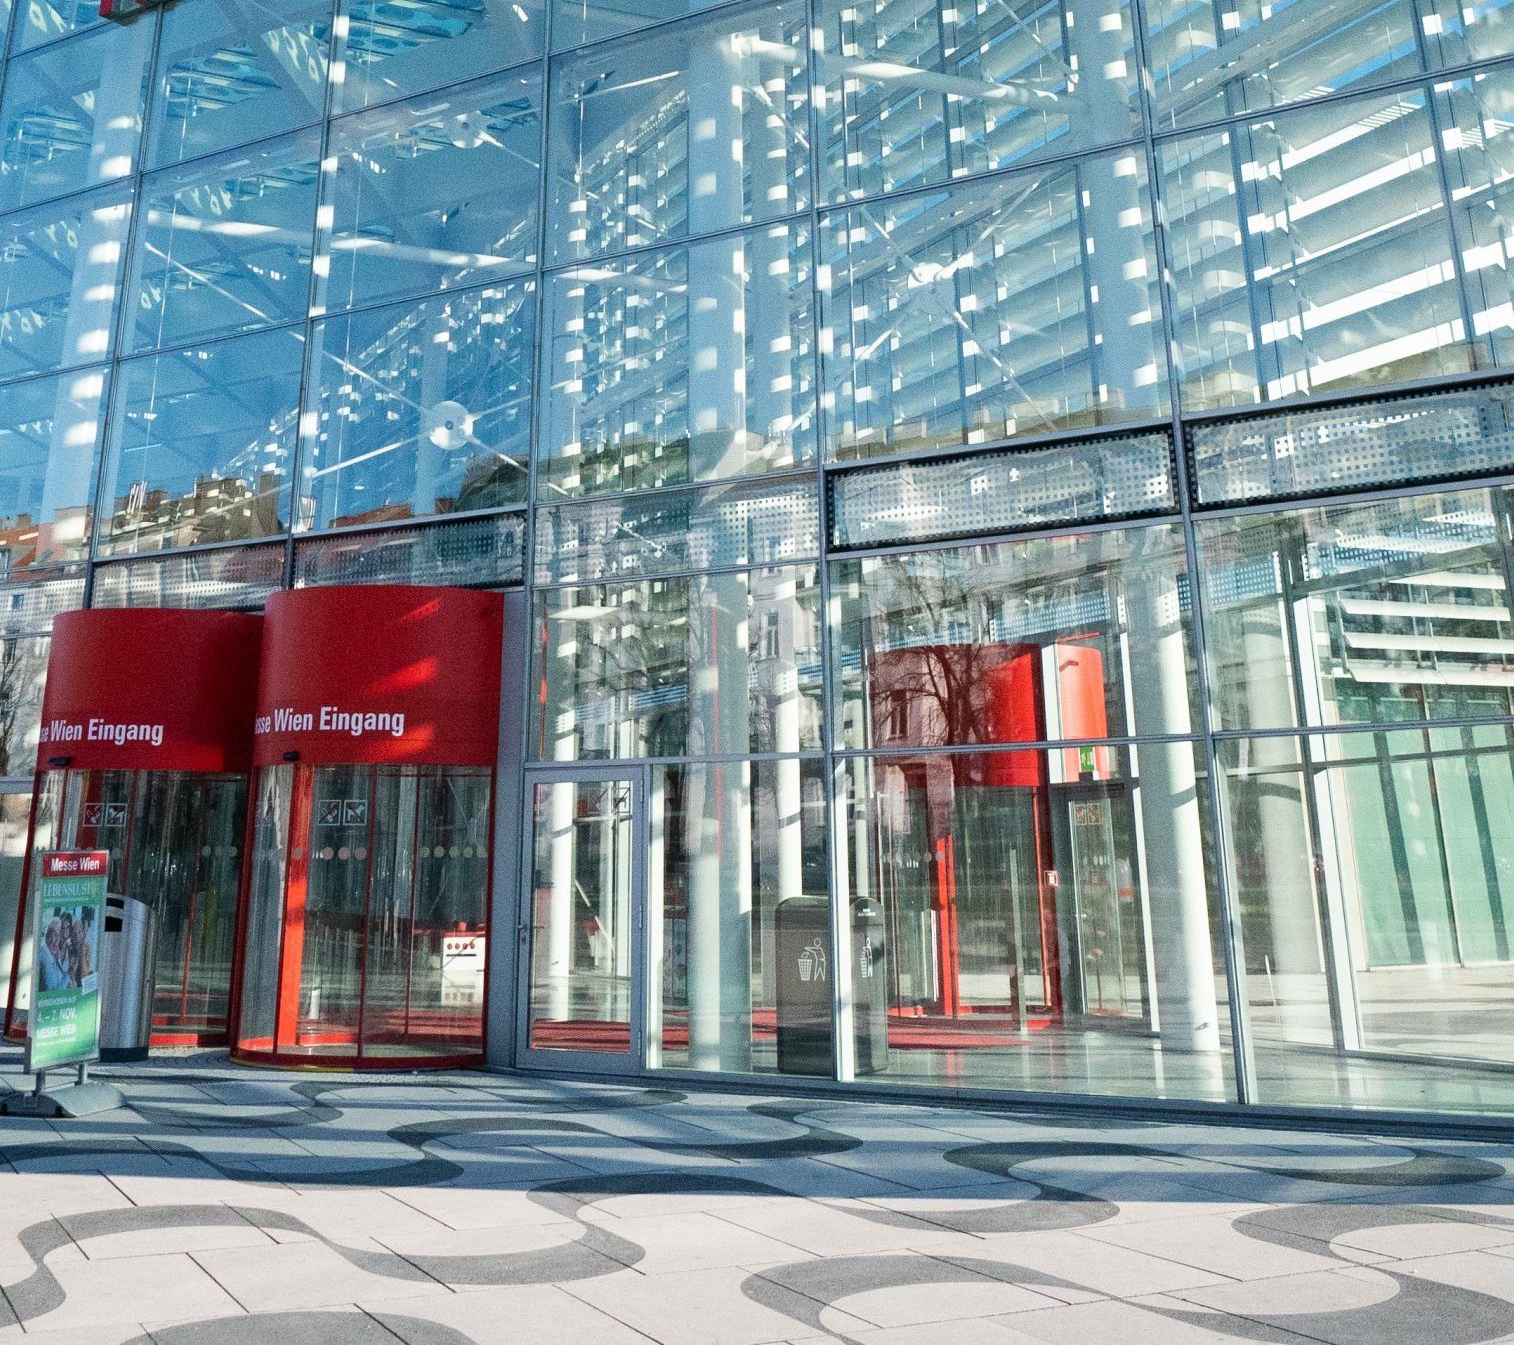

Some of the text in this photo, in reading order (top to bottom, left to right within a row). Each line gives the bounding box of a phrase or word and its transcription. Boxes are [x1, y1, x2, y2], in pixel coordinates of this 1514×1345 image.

[50, 720, 83, 742] Wien
[87, 718, 164, 746] Eingang
[274, 708, 313, 732] Wien
[319, 706, 405, 737] Eingang
[51, 857, 100, 872] Messe Wien
